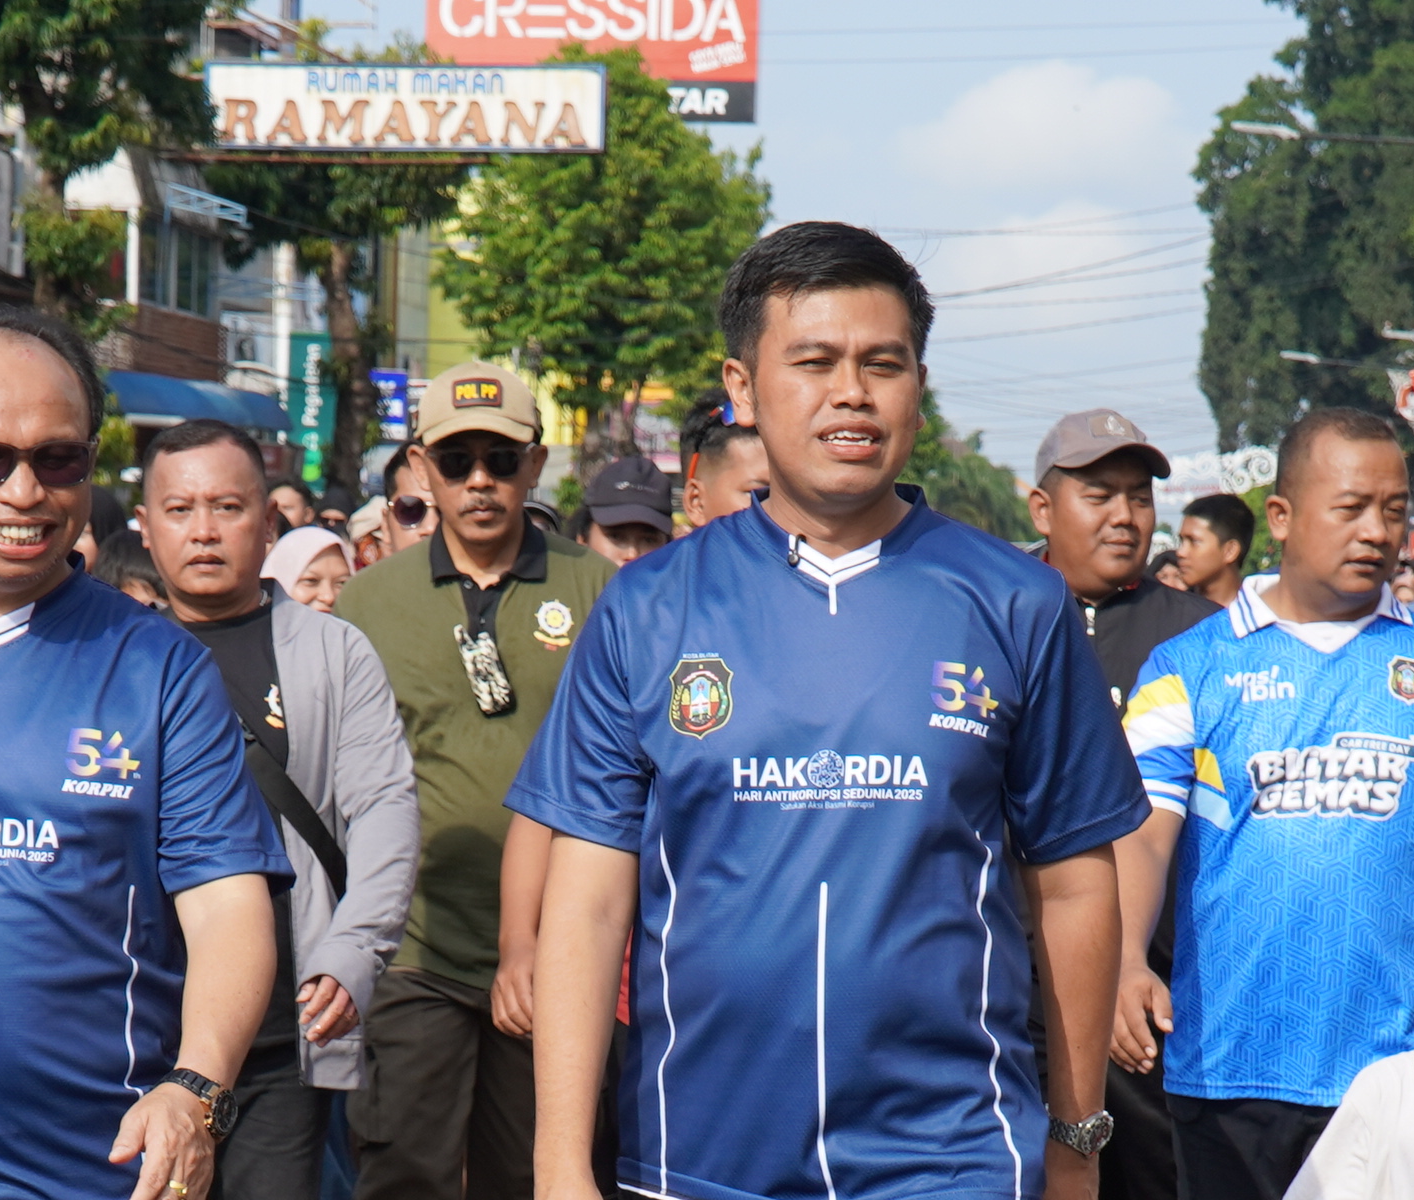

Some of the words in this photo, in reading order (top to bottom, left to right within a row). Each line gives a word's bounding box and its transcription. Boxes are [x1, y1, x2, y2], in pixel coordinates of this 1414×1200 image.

[439, 0, 746, 43] CRESSIDA
[307, 70, 398, 93] RUMAH
[413, 72, 504, 94] MAKAN
[221, 99, 587, 146] RAMAYANA
[455, 385, 479, 400] POL
[480, 384, 498, 400] PP
[929, 713, 989, 738] KORPRI
[61, 779, 134, 799] KORPRI
[734, 790, 762, 802] HARI
[764, 789, 841, 801] ANTIKORUPSI
[843, 788, 893, 800] SEDUNIA
[895, 788, 923, 800] 2025
[1259, 776, 1398, 813] GEMAS
[28, 851, 54, 862] 2025
